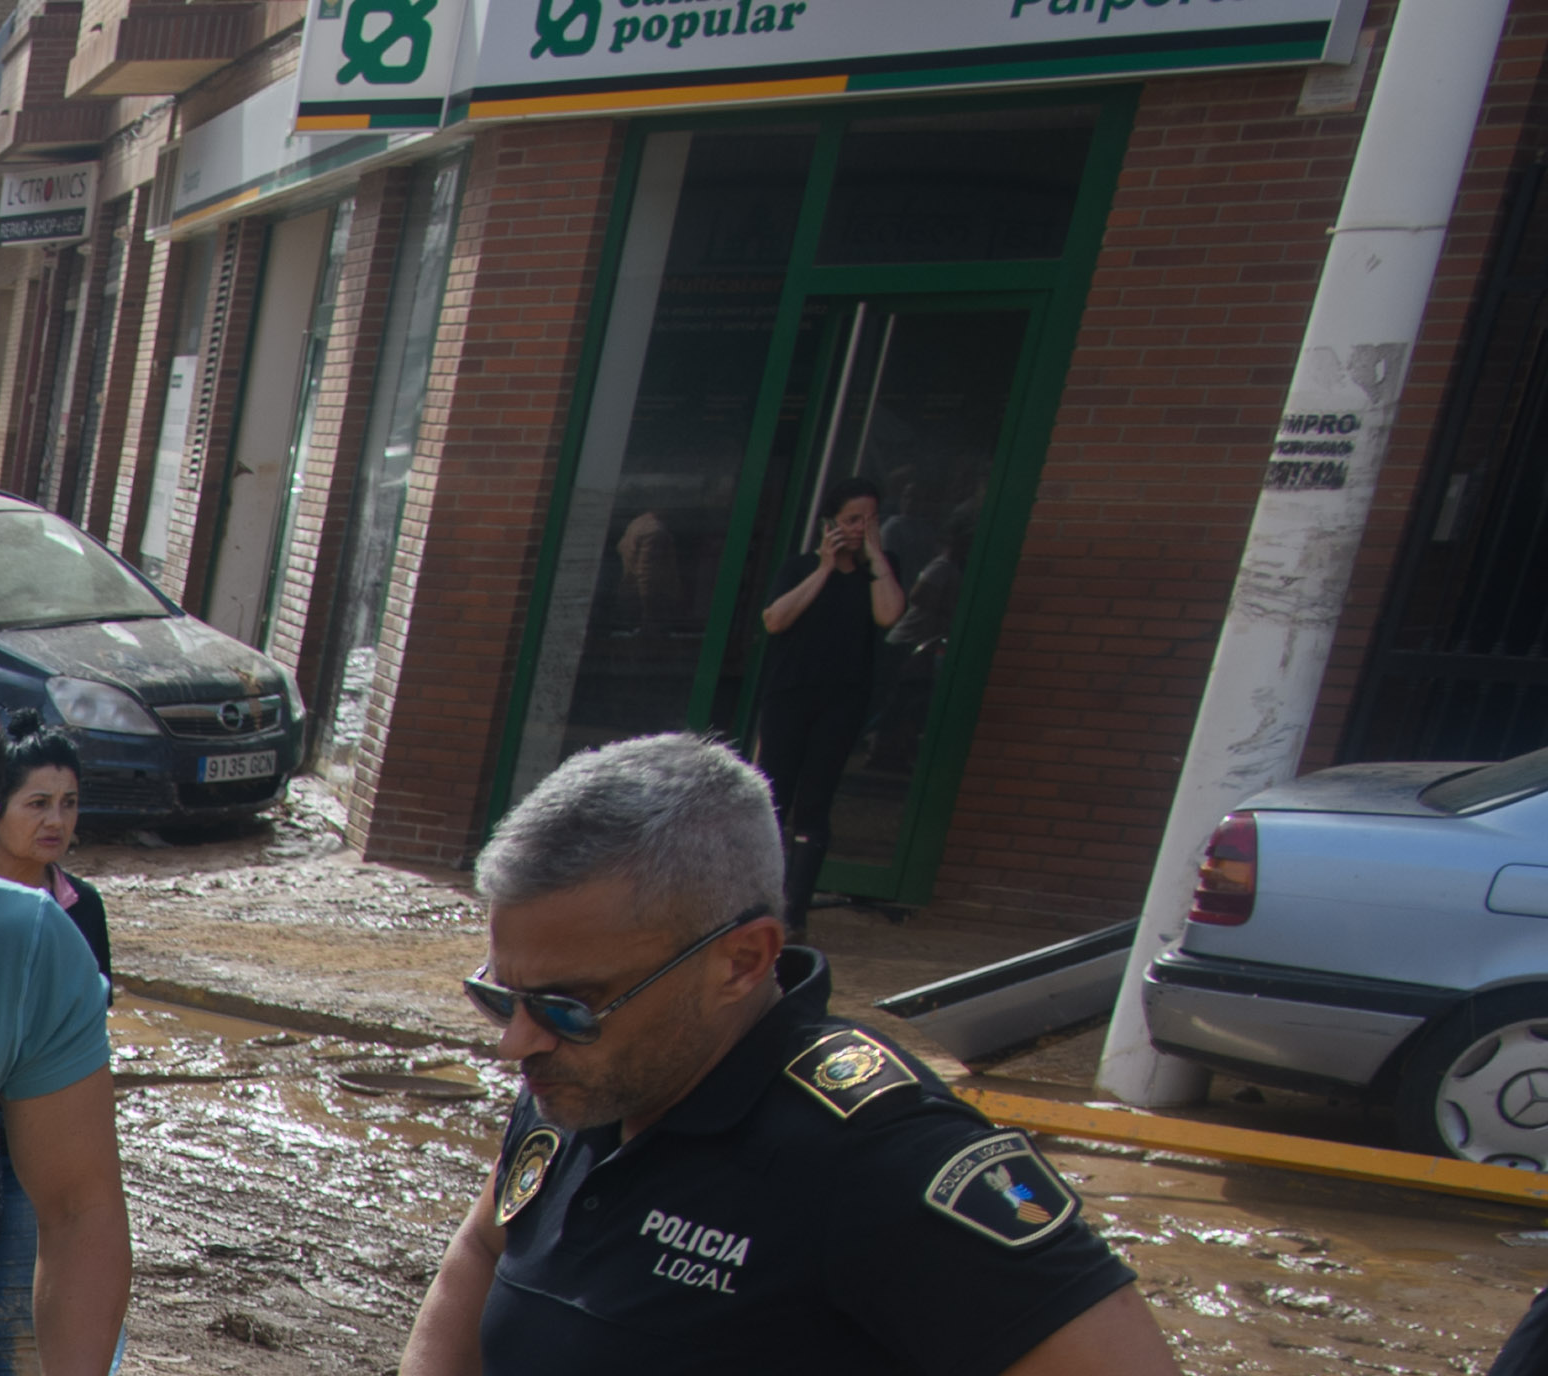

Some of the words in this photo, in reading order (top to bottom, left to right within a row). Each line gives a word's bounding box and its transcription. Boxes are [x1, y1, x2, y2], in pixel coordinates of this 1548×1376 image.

[608, 1, 806, 53] popular
[208, 756, 245, 778] 9135
[977, 1141, 1016, 1159] LOCAL
[937, 1158, 976, 1196] POLICIA
[640, 1208, 751, 1267] POLICIA
[652, 1252, 736, 1294] LOCAL
